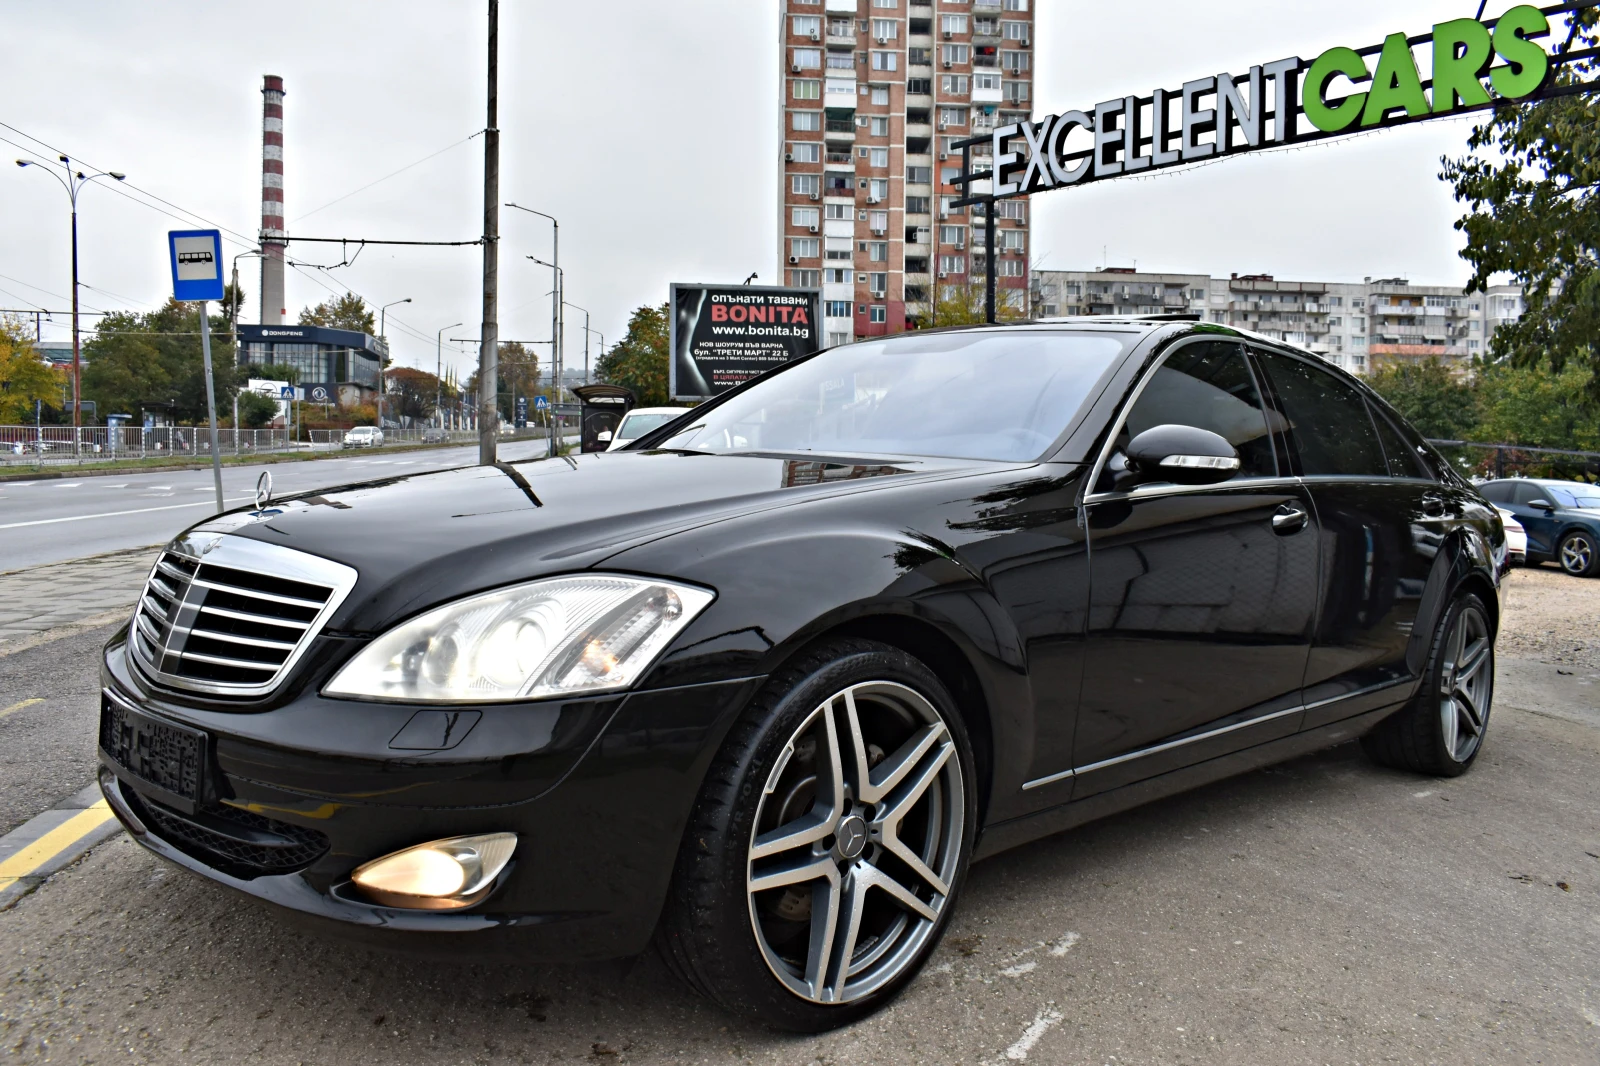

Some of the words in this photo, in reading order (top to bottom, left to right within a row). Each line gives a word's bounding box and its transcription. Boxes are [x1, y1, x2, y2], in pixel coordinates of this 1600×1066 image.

[991, 56, 1301, 197] EXCELLENT
[1302, 5, 1549, 132] CARS
[711, 294, 764, 304] опънати
[767, 296, 808, 306] тавани
[711, 304, 808, 324] BONITA
[712, 325, 809, 339] www.bonita.bg
[694, 348, 711, 356] бул.
